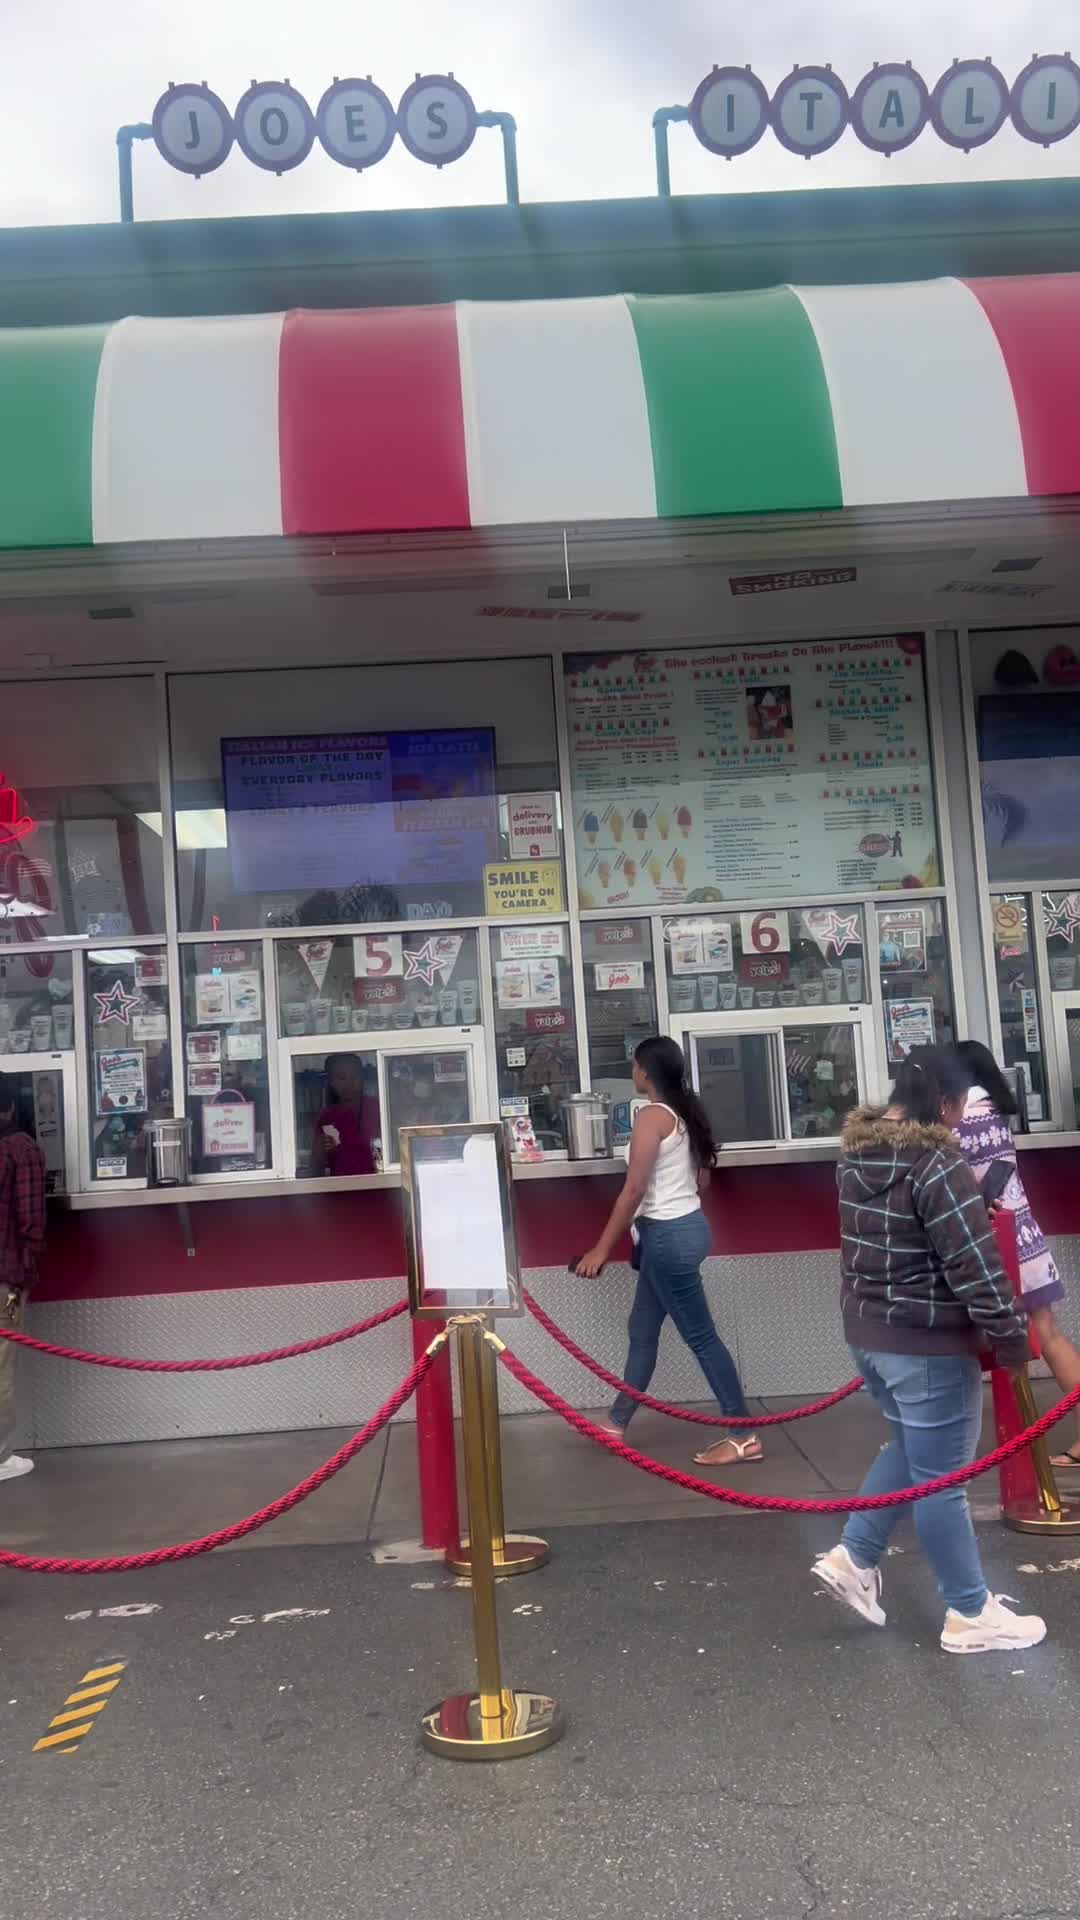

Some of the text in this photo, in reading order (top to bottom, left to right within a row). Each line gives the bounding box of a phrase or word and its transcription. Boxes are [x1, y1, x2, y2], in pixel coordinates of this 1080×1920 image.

[726, 82, 1057, 133] ITALI
[184, 101, 449, 149] JOES
[735, 571, 851, 593] SMOKING
[773, 572, 812, 583] NO
[240, 751, 384, 766] FLAVOR OF THE DAY
[241, 772, 384, 786] EVERYDAY FLAVORS
[513, 811, 553, 821] delivery
[514, 825, 553, 837] GRUBHUB
[488, 871, 539, 886] SMILE
[494, 888, 555, 899] YOU'RE ON
[502, 899, 547, 909] CAMERA
[752, 912, 780, 953] 6
[366, 935, 392, 976] 5
